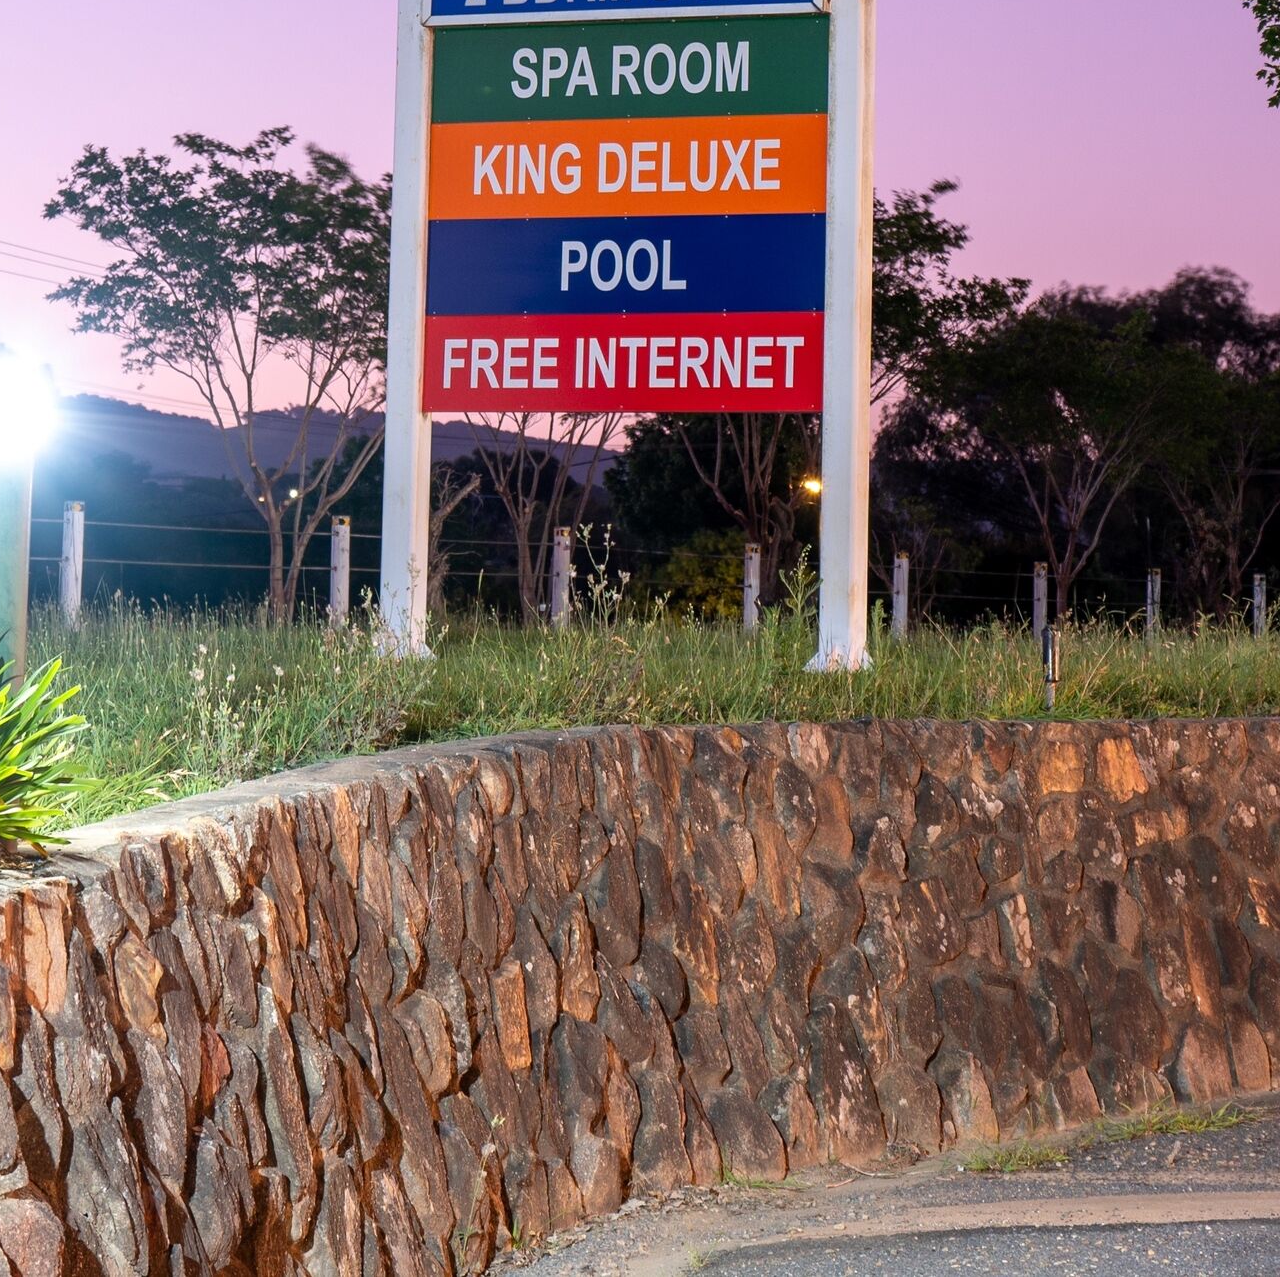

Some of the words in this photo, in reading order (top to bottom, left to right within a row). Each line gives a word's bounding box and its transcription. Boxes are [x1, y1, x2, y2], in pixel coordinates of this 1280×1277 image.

[511, 47, 598, 99] SPA
[612, 41, 749, 96] ROOM
[473, 143, 581, 195] KING
[598, 139, 780, 193] DELUXE
[561, 239, 686, 291] POOL
[443, 338, 559, 389] FREE
[575, 336, 804, 389] INTERNET
